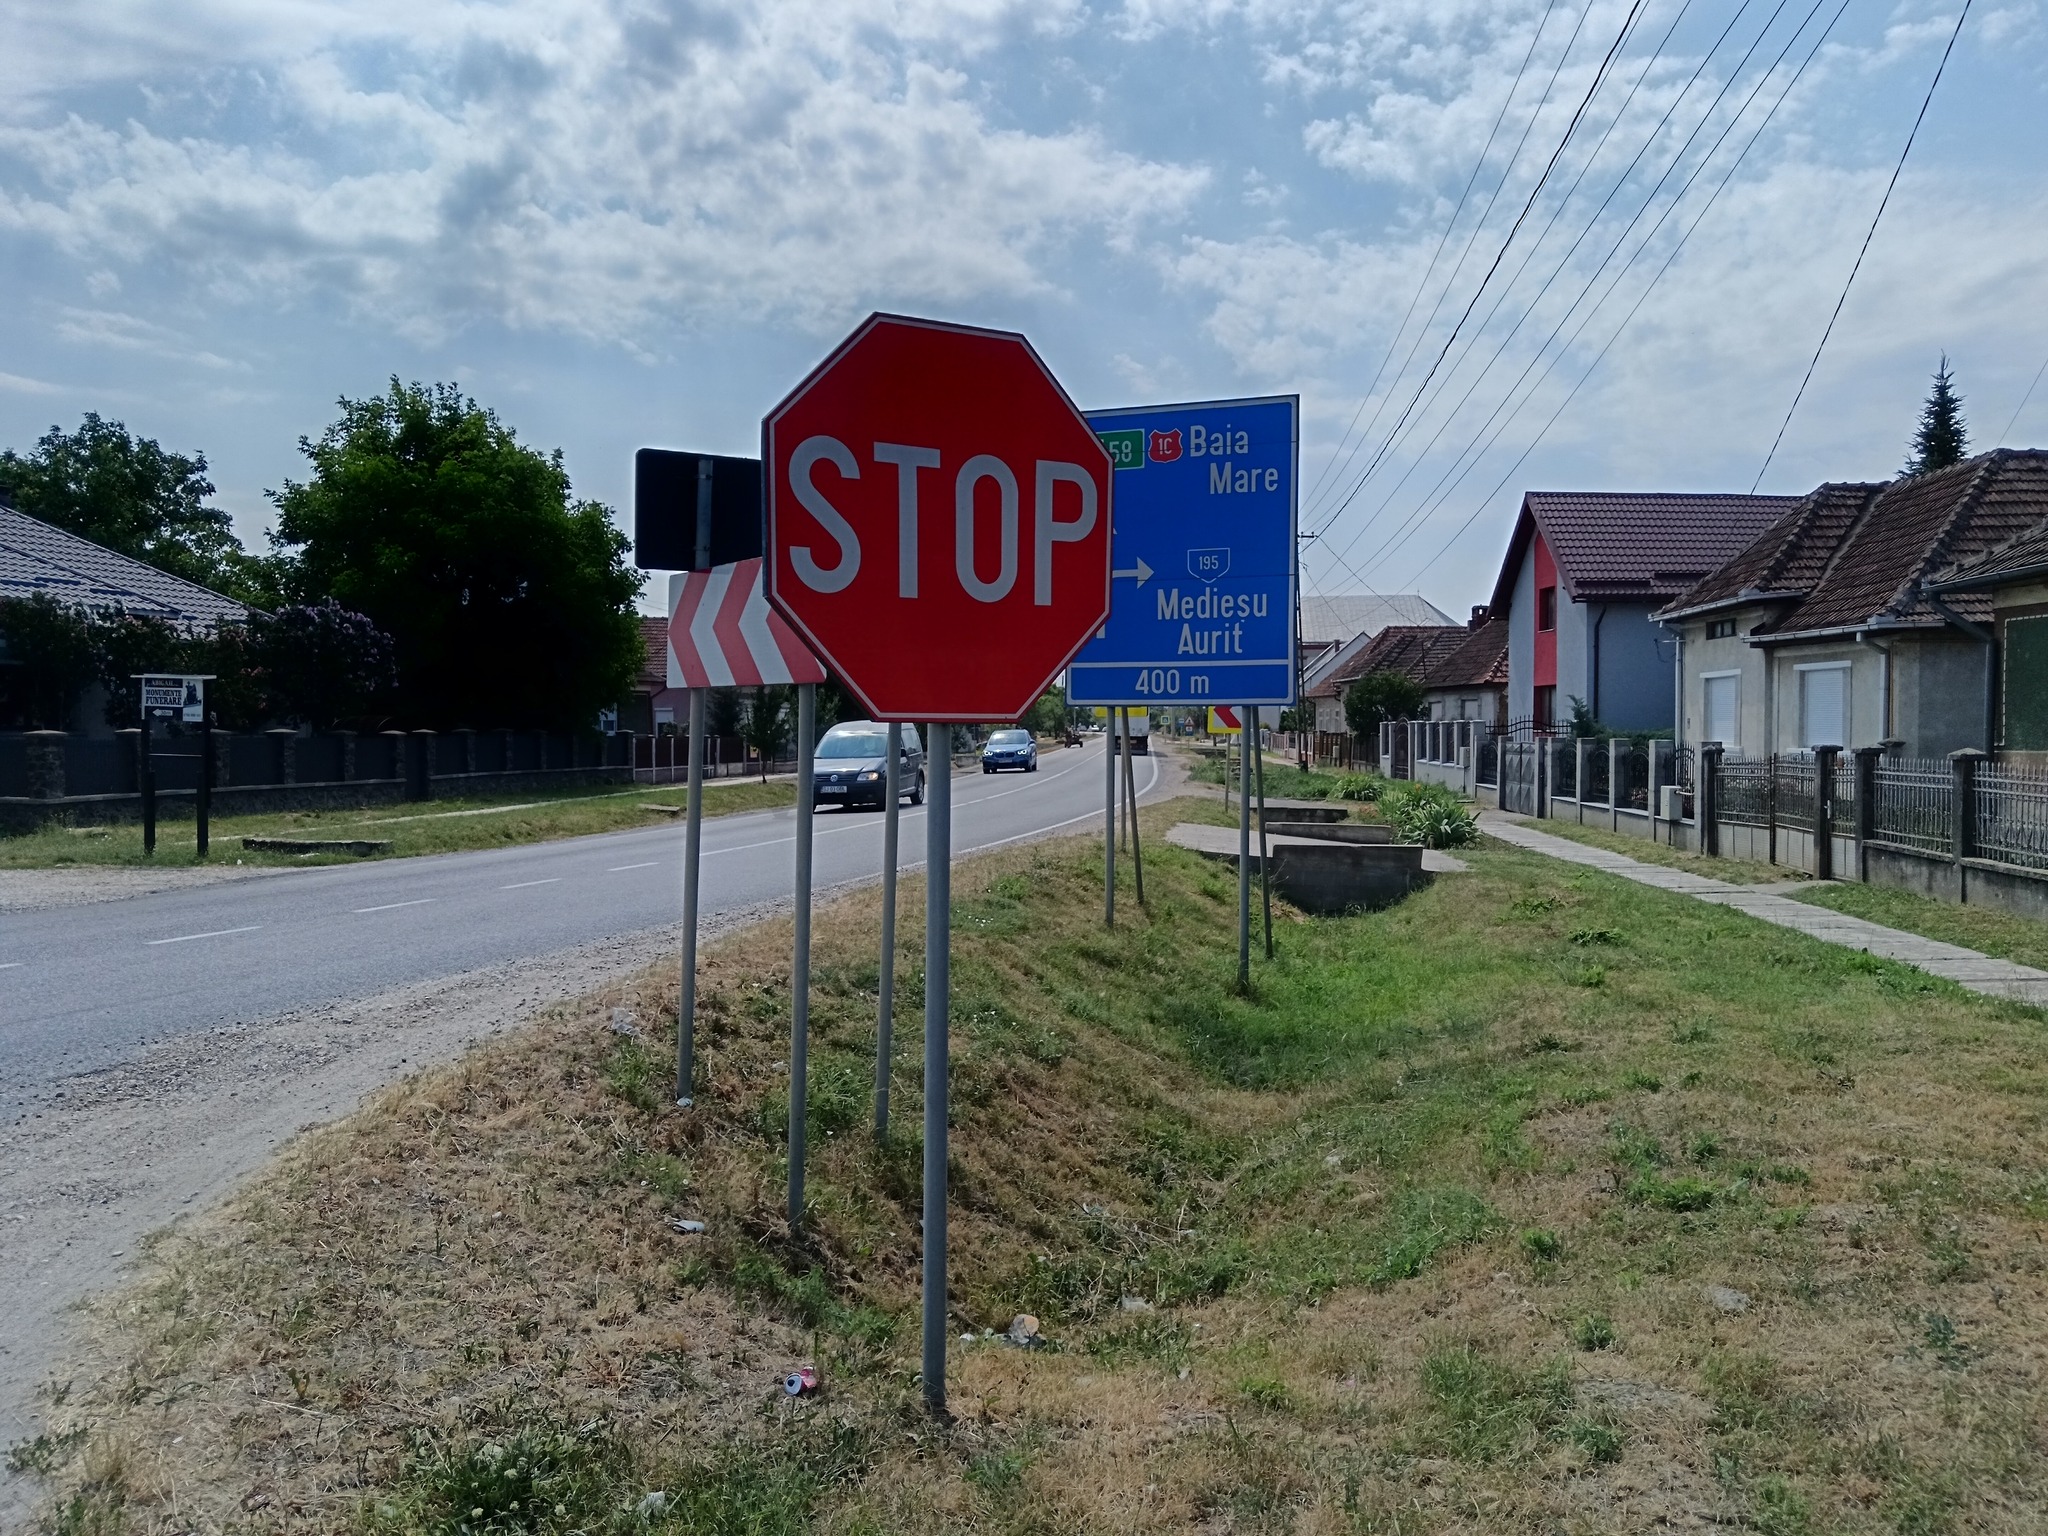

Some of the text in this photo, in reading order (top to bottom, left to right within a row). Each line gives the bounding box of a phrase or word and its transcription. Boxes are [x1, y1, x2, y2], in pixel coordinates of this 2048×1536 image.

[1101, 439, 1132, 463] 58
[1158, 437, 1173, 455] 1C
[1190, 424, 1249, 457] Baia
[1209, 461, 1279, 495] Mare
[788, 435, 1098, 606] STOP
[1199, 555, 1219, 571] 195
[1177, 622, 1243, 655] Aurit
[145, 689, 182, 697] MONUMENTE
[1135, 669, 1210, 695] 400 m
[145, 697, 182, 706] FUNERARE
